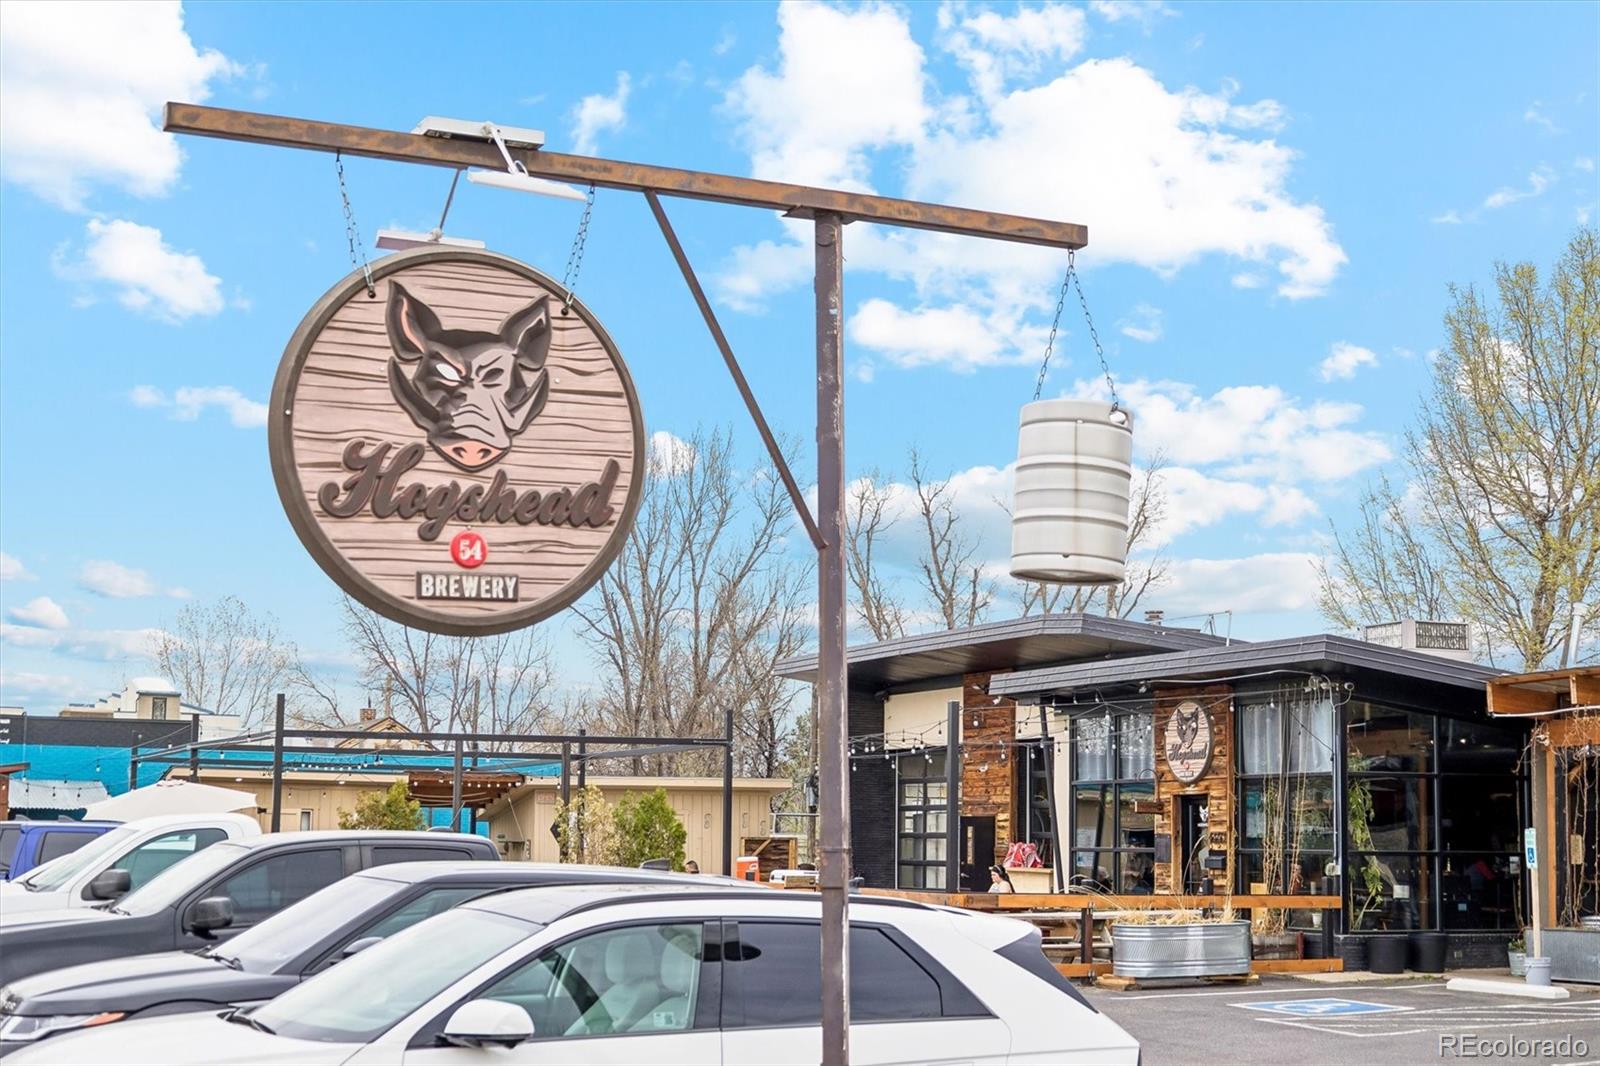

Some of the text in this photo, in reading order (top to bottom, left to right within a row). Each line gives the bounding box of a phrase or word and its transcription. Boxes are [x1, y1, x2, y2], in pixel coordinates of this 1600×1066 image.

[317, 438, 620, 541] Hogshead
[459, 539, 482, 561] 54
[421, 574, 517, 599] BREWERY
